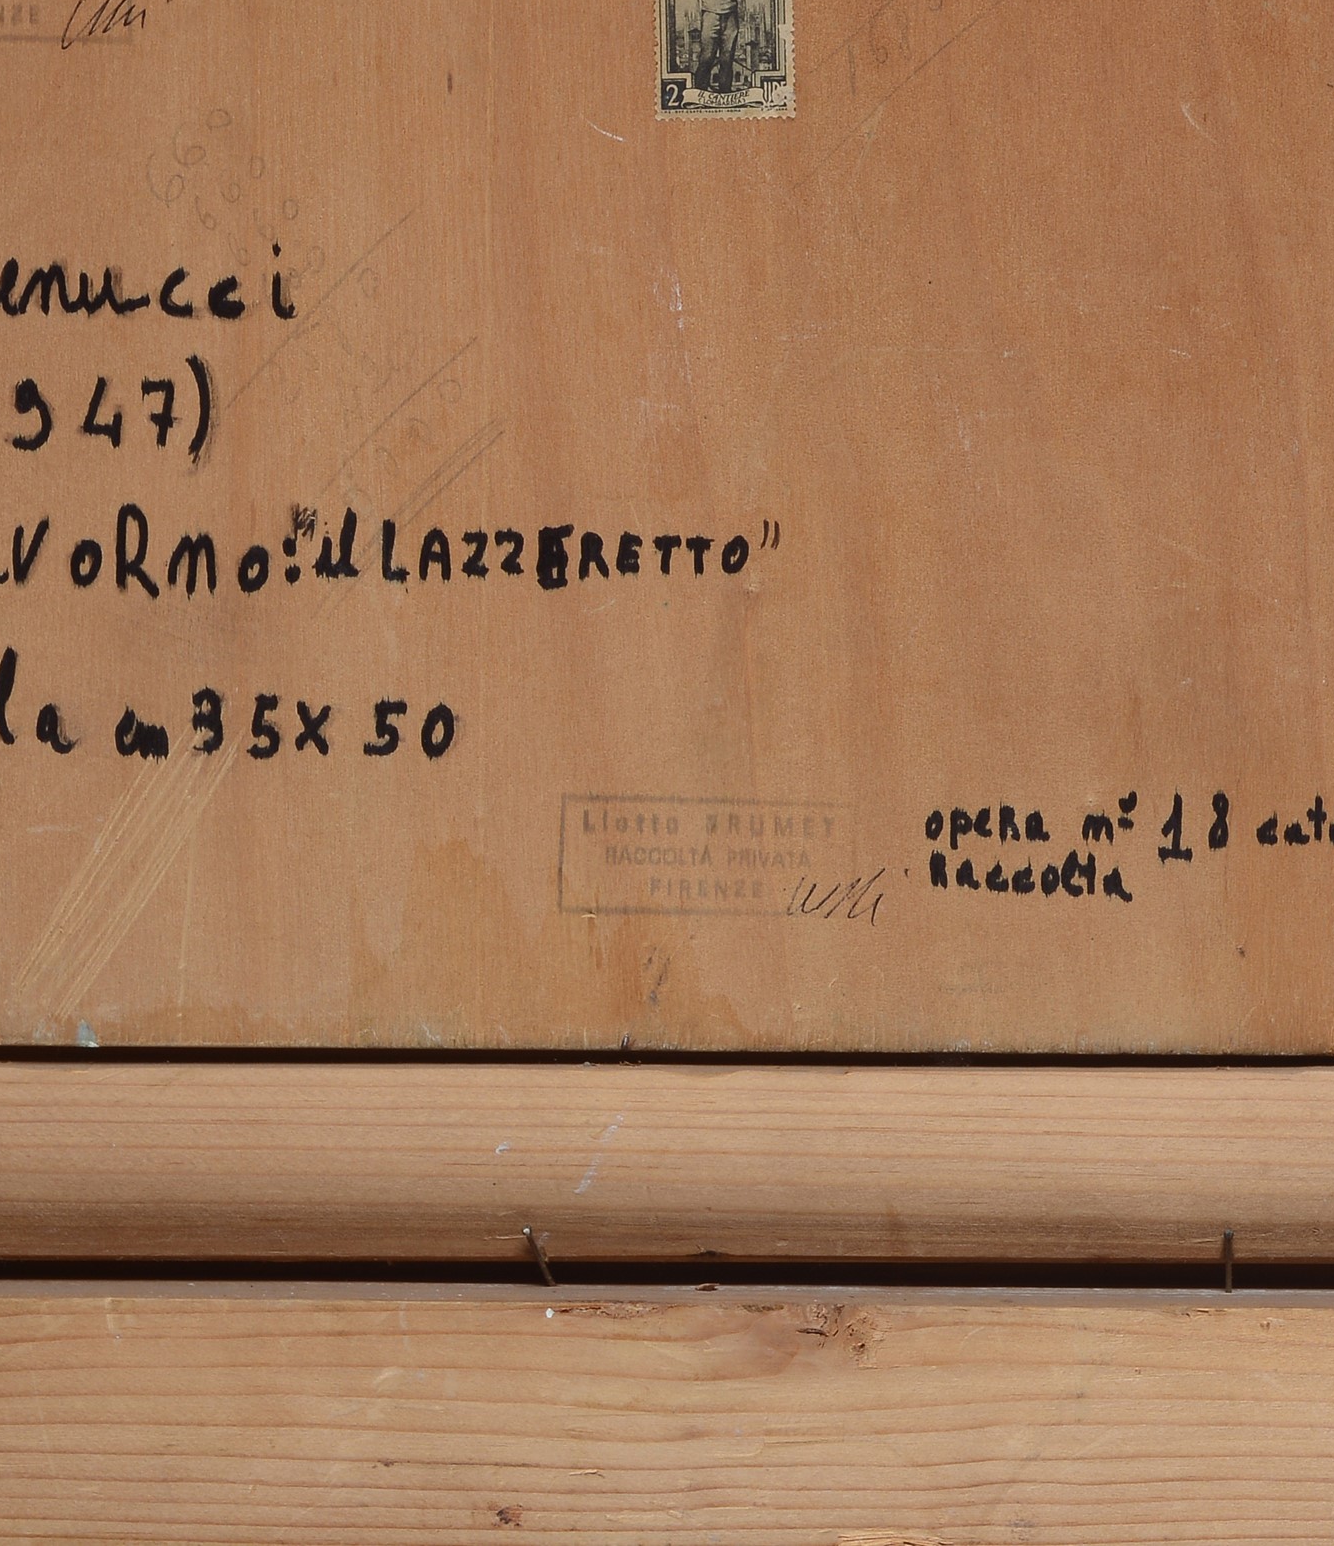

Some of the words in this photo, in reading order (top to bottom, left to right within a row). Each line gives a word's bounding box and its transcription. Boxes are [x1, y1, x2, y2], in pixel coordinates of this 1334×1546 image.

[665, 84, 680, 106] 2
[1158, 787, 1230, 863] 18
[604, 844, 713, 869] RACCOLTA
[727, 847, 813, 870] PRIVATA
[649, 877, 765, 900] FIRENZE
